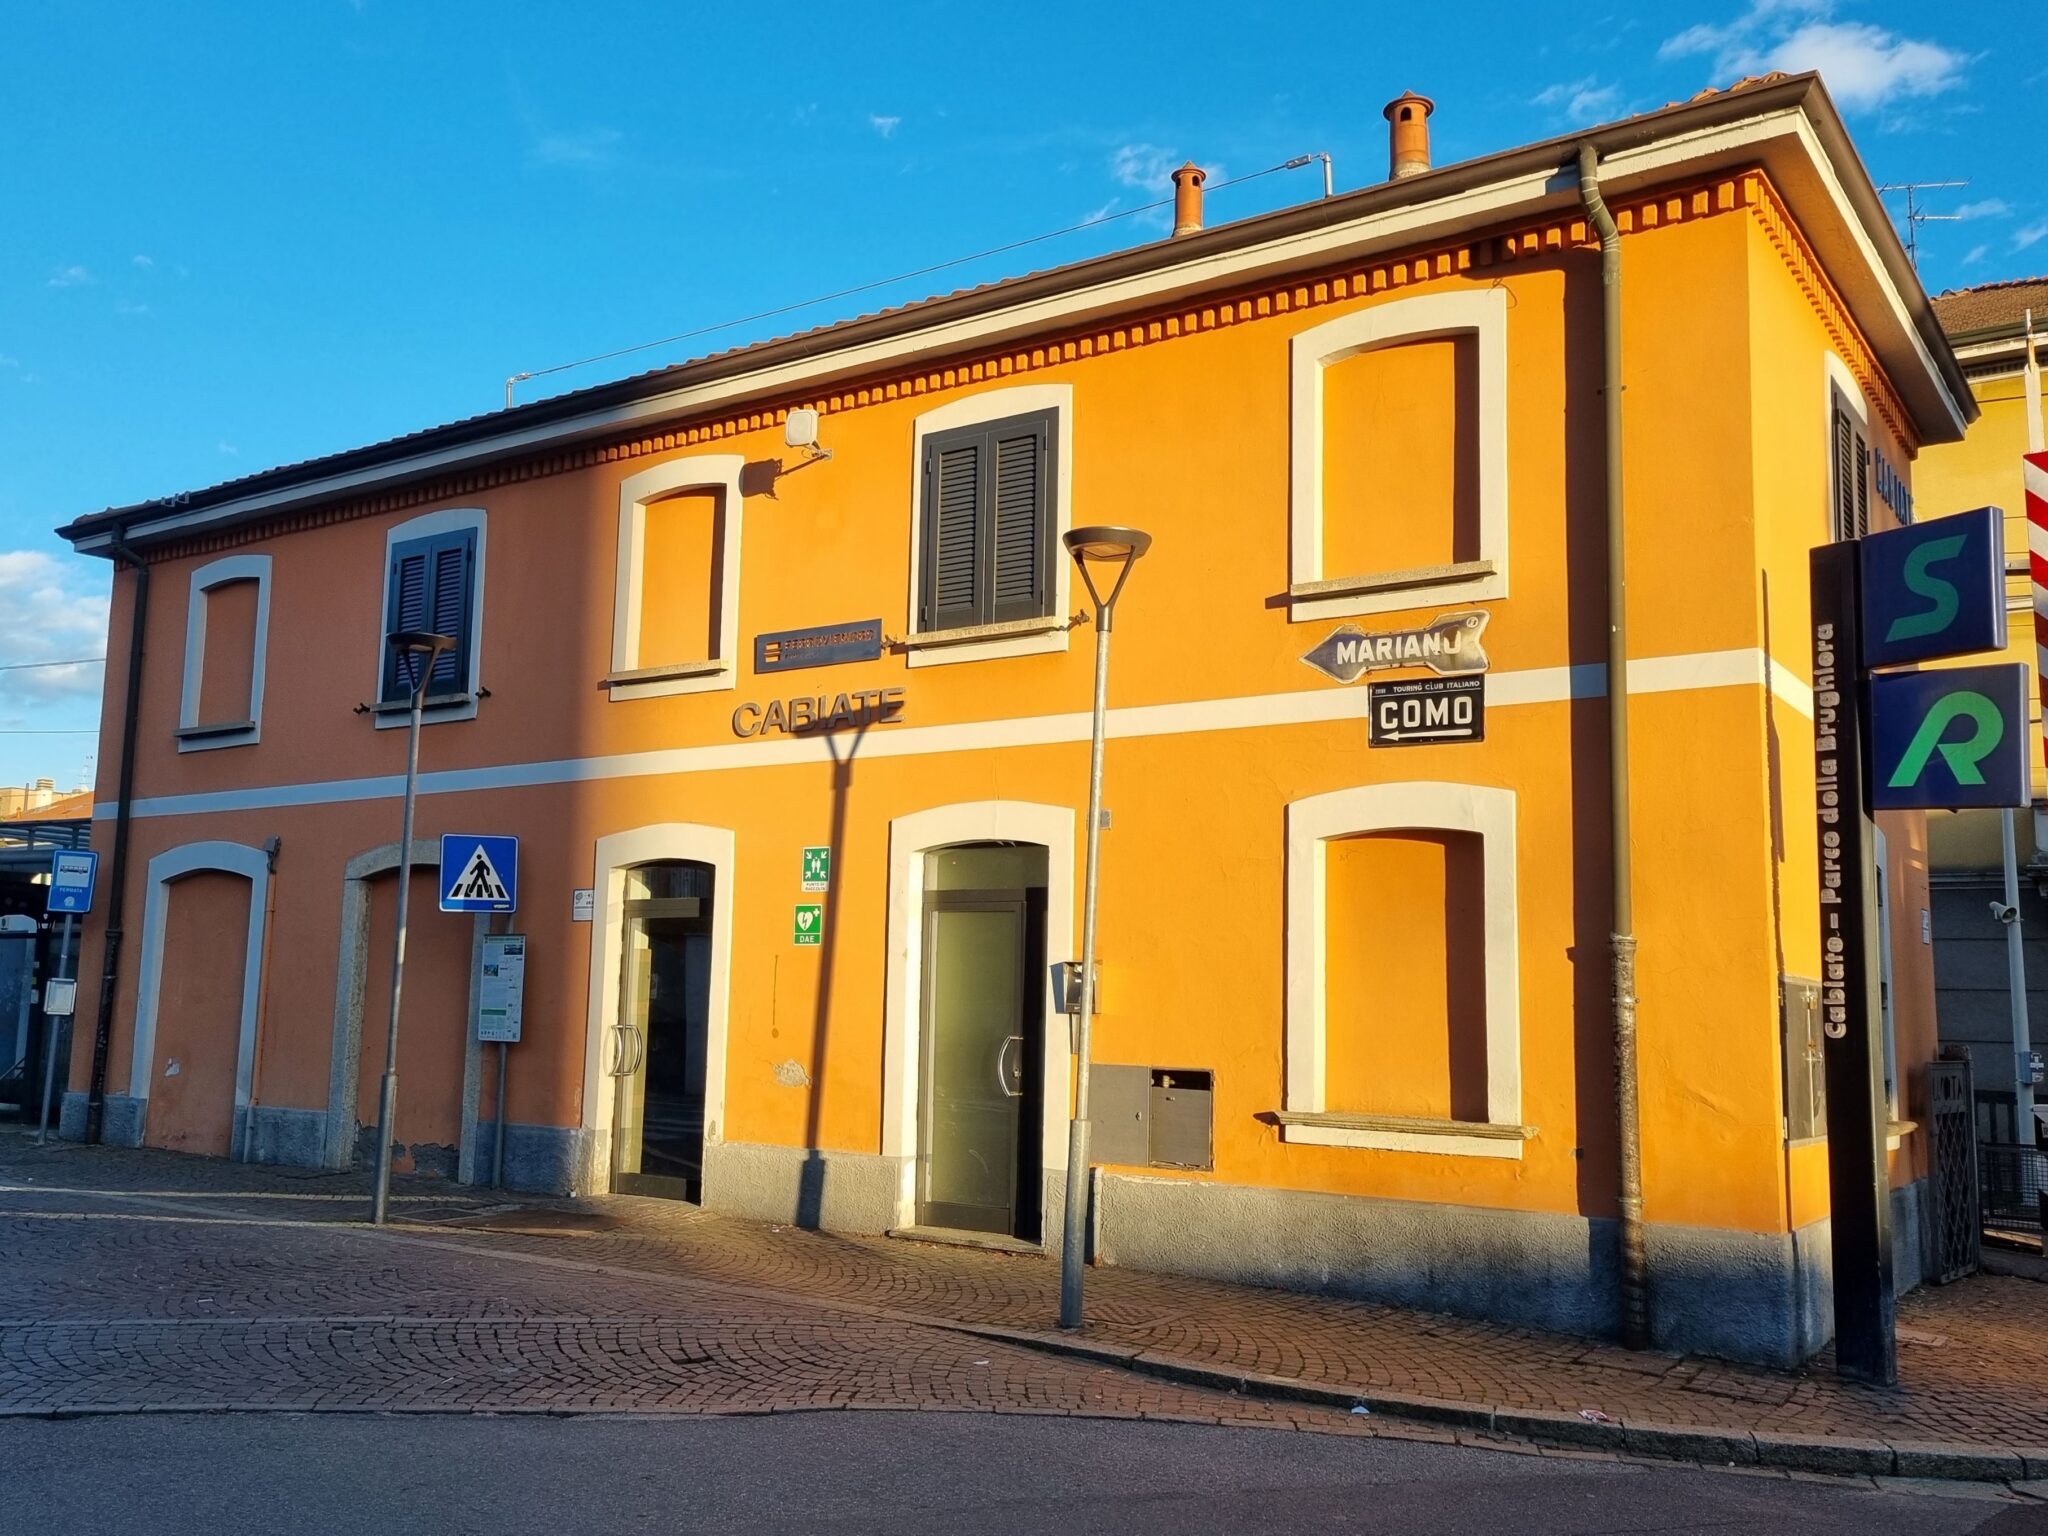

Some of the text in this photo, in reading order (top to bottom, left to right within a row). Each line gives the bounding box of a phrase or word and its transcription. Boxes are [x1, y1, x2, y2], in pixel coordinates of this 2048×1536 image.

[1885, 534, 1969, 643] S
[732, 687, 906, 738] CABIATE
[1393, 684, 1423, 693] TOURING
[1425, 682, 1444, 691] CLUB
[1447, 681, 1480, 689] ITALIANO
[1380, 696, 1473, 730] COMO
[1887, 691, 2004, 788] R
[1820, 831, 1842, 904] Parco
[799, 935, 815, 943] DAE
